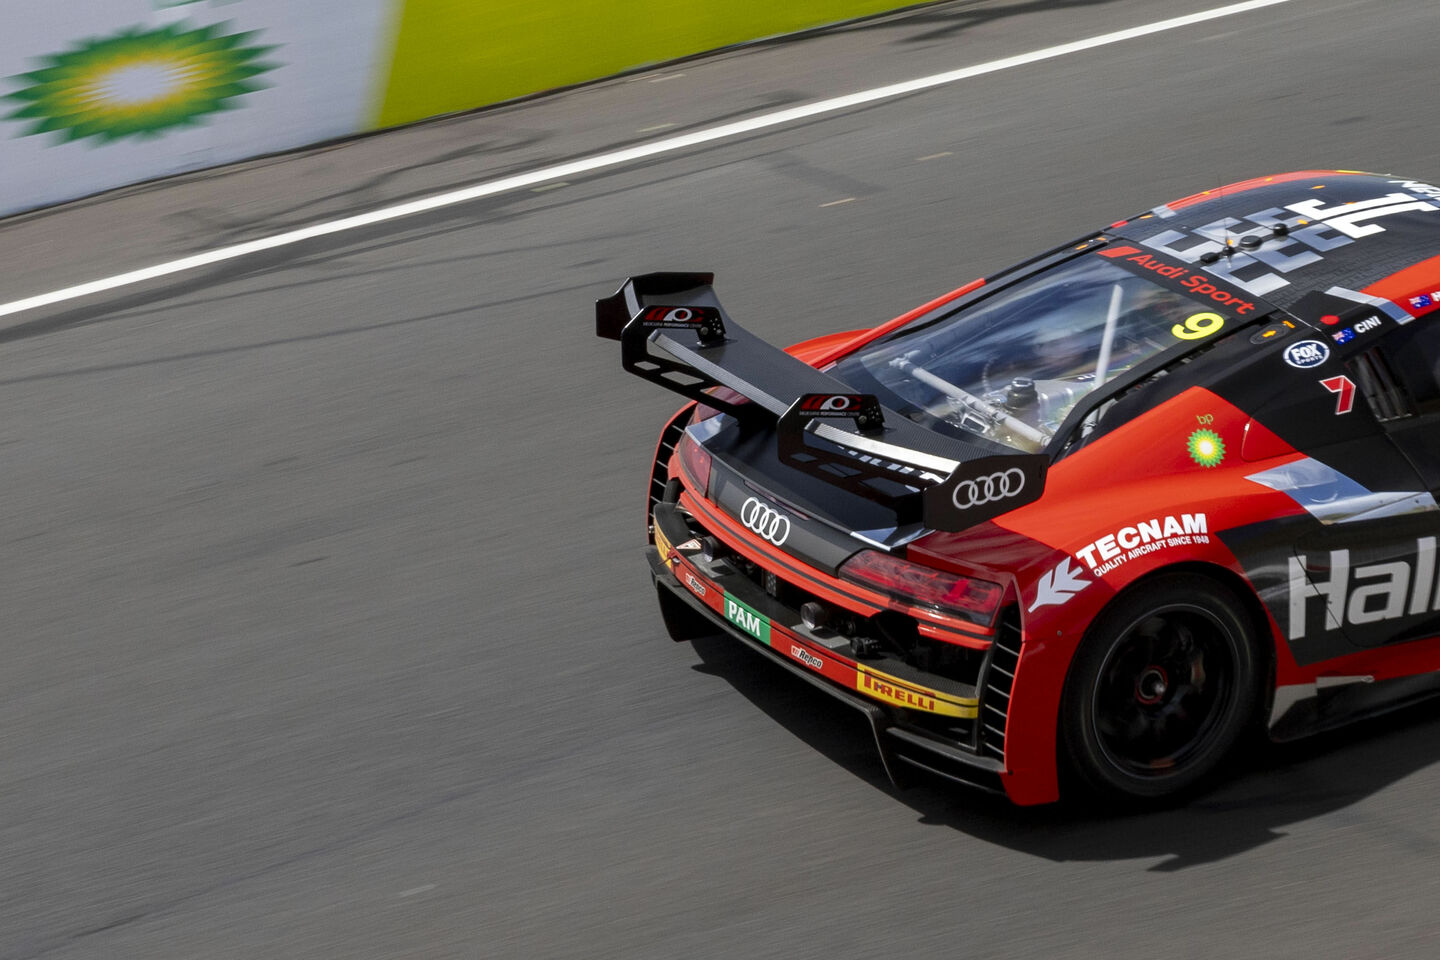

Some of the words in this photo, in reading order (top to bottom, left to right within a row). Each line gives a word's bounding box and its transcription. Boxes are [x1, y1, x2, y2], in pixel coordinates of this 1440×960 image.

[1127, 254, 1189, 279] Audi
[1180, 275, 1255, 315] Sport
[1171, 312, 1225, 340] 9
[1354, 315, 1382, 334] CINI
[1290, 343, 1319, 361] FOX
[1296, 354, 1324, 365] SPORTS
[1318, 375, 1356, 415] 7
[1196, 414, 1214, 425] bp
[1076, 513, 1208, 569] TECNAM
[1093, 554, 1127, 577] QUALITY
[1127, 540, 1167, 560] AIRCRAFT
[1167, 536, 1192, 547] SINCE
[728, 600, 761, 636] PAM
[798, 649, 823, 669] Repco
[863, 669, 937, 711] PIRELLI
